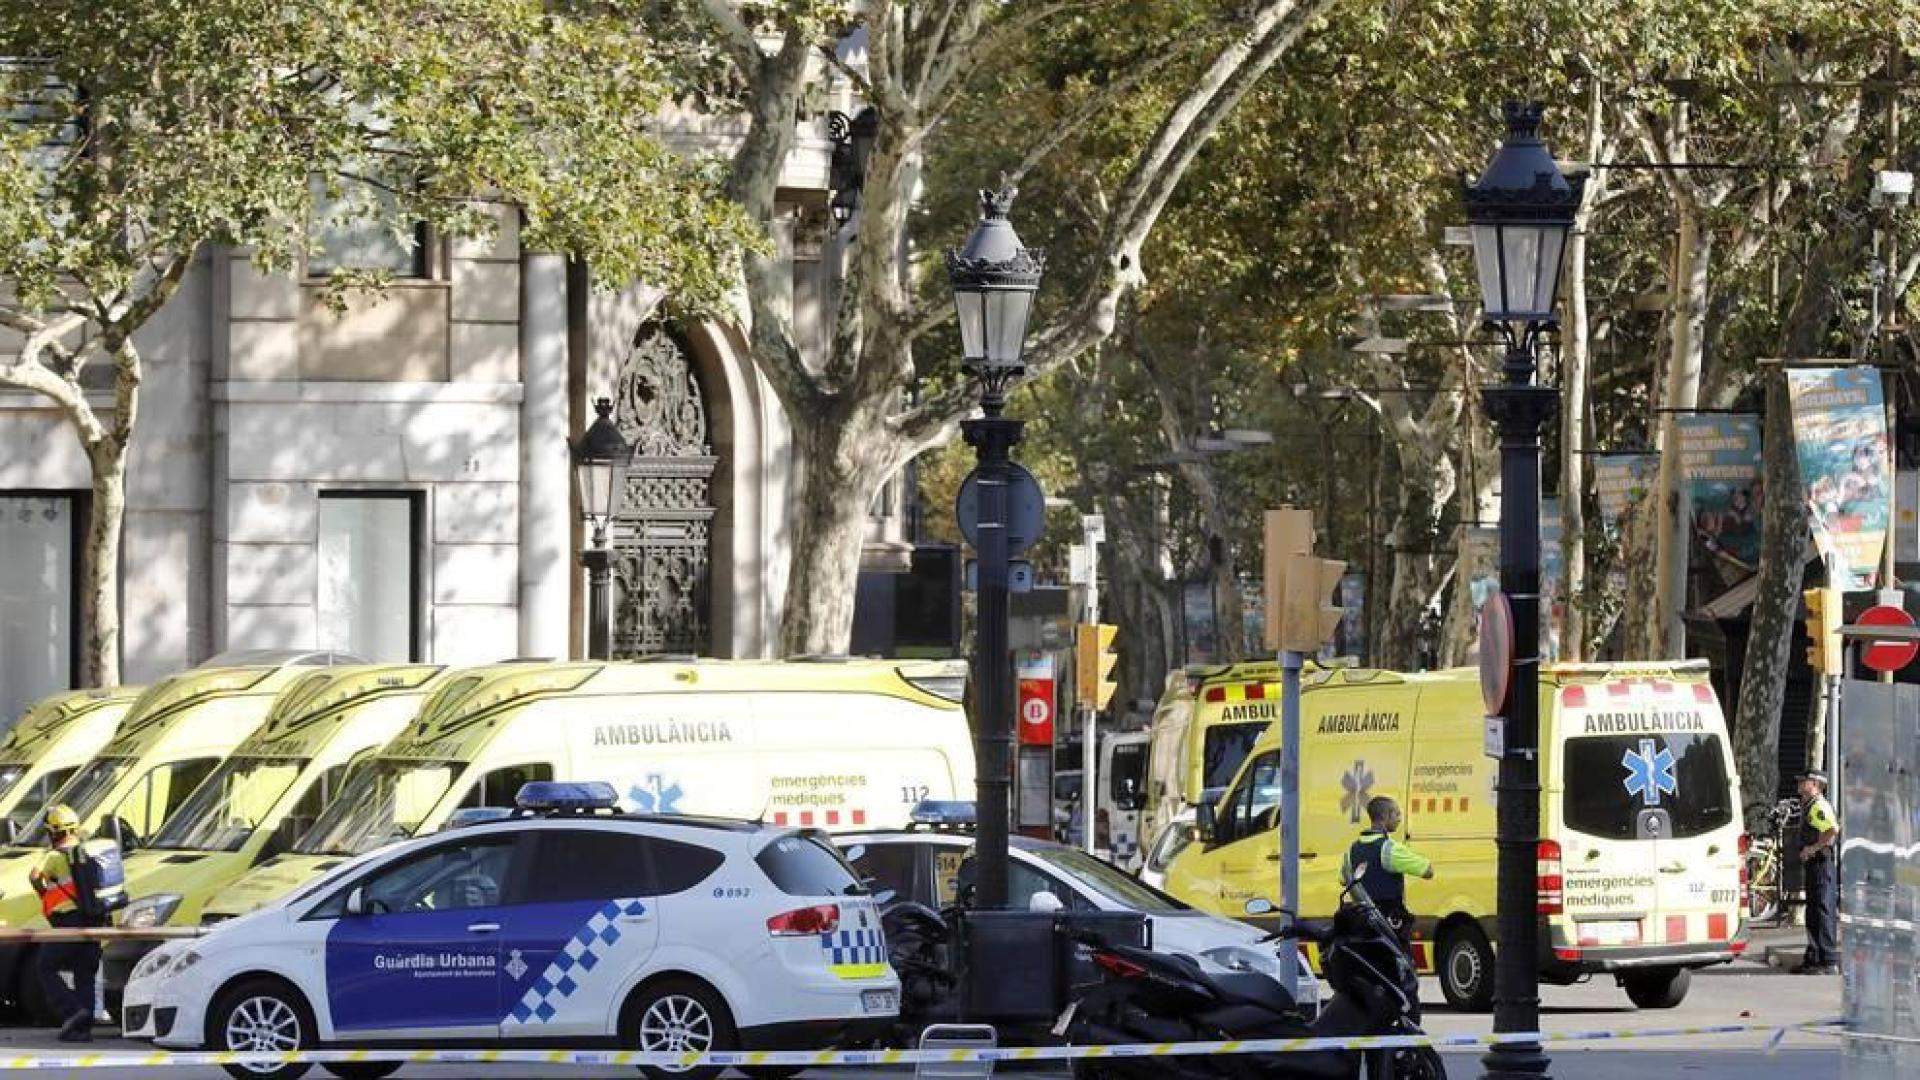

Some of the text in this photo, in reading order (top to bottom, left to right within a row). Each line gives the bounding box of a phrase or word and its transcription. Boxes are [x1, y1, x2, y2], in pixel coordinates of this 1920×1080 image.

[1222, 703, 1278, 721] AMBUL
[594, 718, 732, 746] AMBULÀNCIA
[439, 953, 496, 968] Urbana
